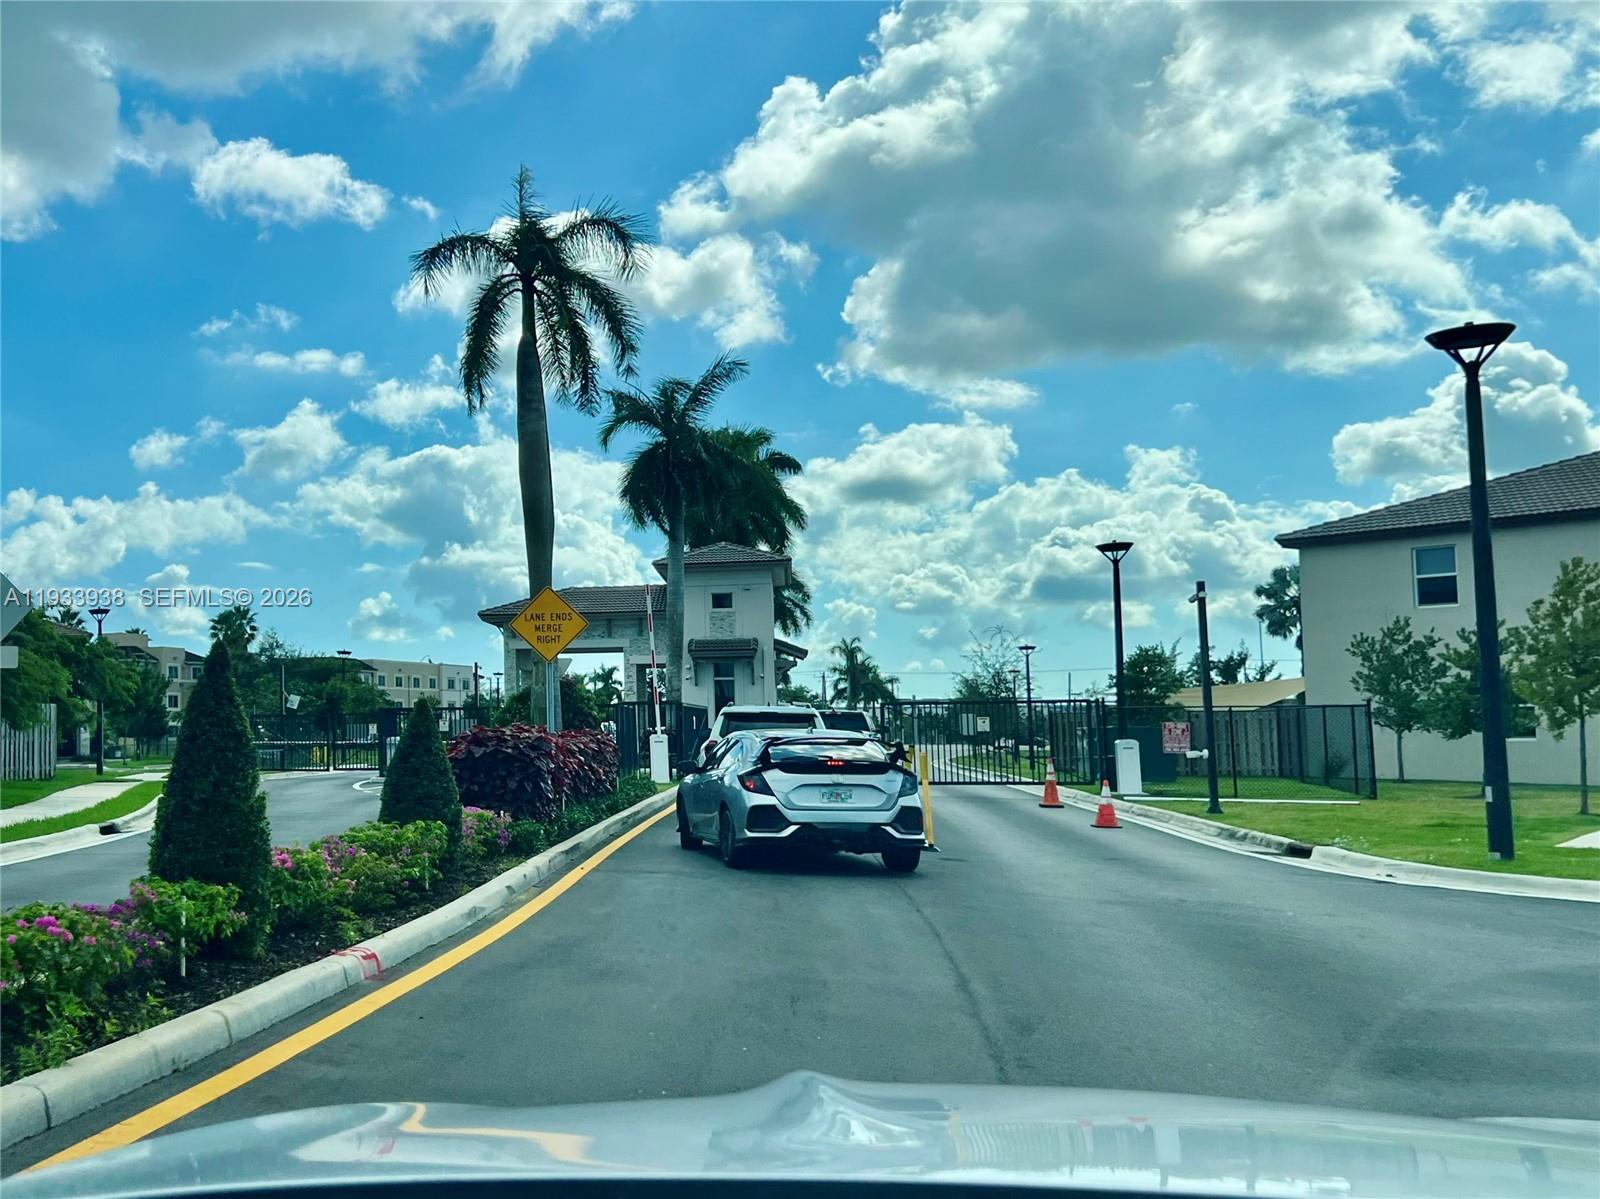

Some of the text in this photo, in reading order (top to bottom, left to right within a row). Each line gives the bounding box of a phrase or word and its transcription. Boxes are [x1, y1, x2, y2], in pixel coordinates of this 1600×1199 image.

[524, 612, 573, 622] LANE ENDS
[534, 623, 563, 633] MERGE
[536, 635, 561, 644] RIGHT
